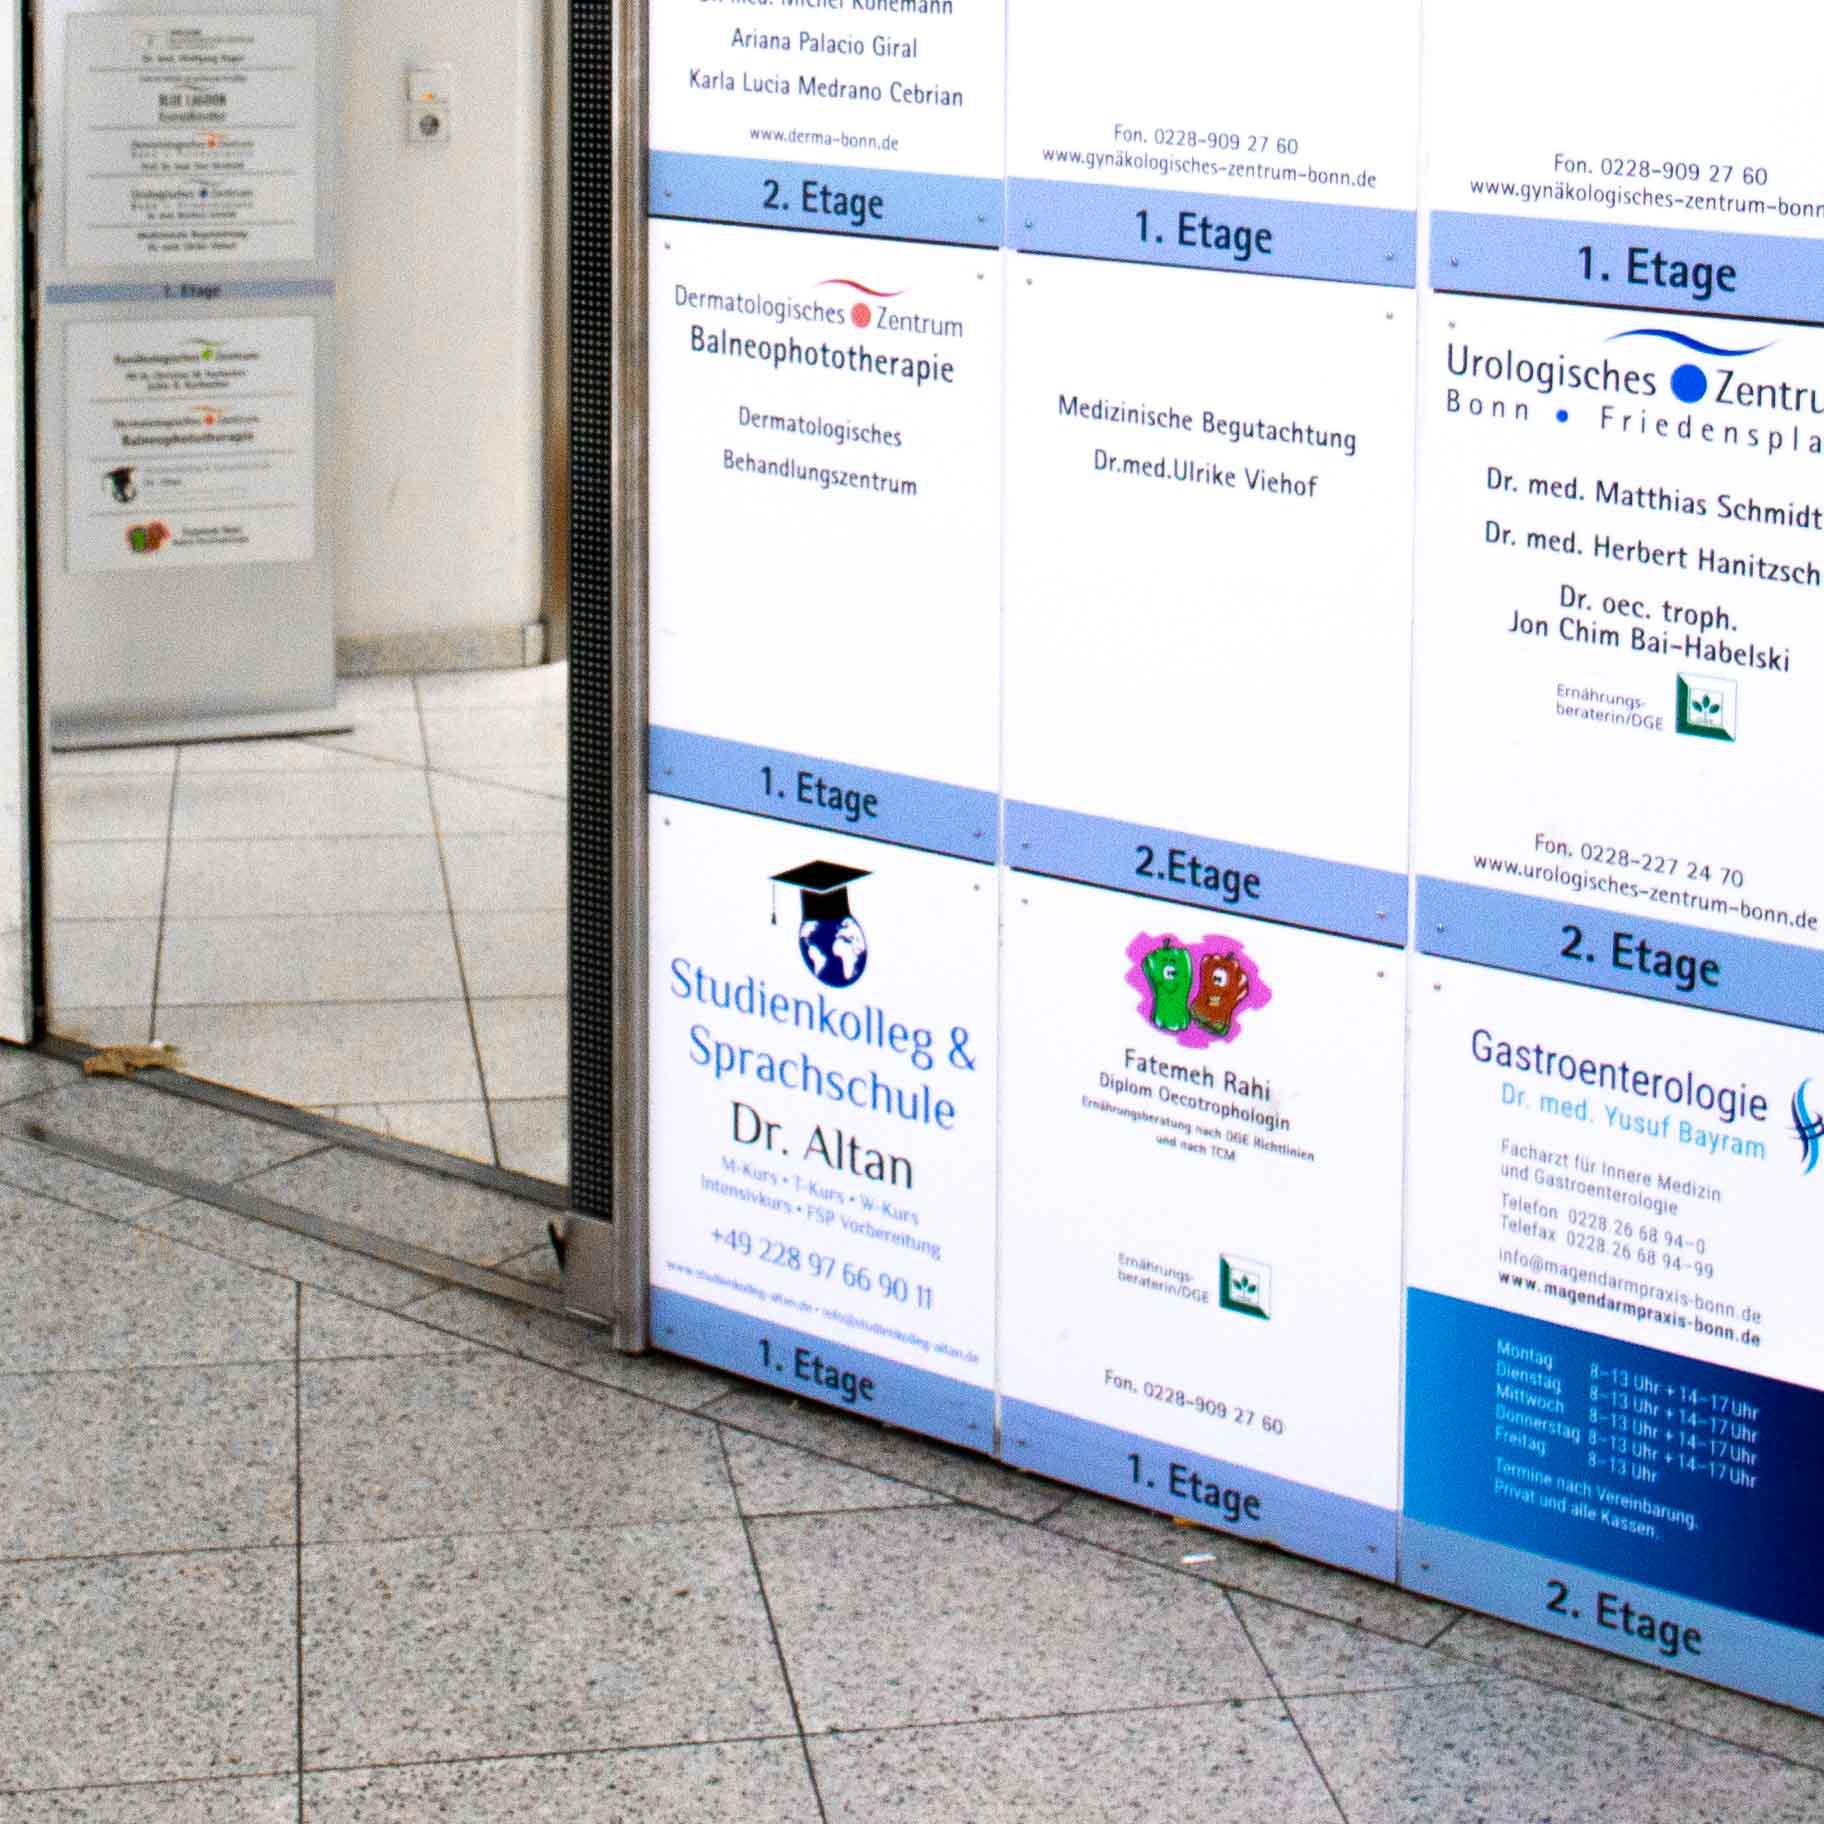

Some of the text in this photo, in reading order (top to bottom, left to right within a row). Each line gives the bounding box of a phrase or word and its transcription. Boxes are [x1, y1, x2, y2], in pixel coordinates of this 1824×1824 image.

[750, 129, 899, 151] www.derma-bonn.de
[763, 179, 884, 227] 2. Etage
[1136, 210, 1272, 263] 1. Etage
[1578, 246, 1737, 301] 1. Etage
[675, 283, 963, 338] Dermatologisches Zentrum
[691, 324, 954, 384] Balneophototherapie
[1448, 343, 1657, 397] Urologisches
[739, 405, 902, 448] Dermatologisches
[1058, 394, 1357, 457] Medizinische Begutachtung
[1446, 388, 1528, 421] Bonn
[723, 448, 918, 496] Behandlungszentrum
[1094, 448, 1318, 497] Dr.med.Ulrike Viehof
[761, 765, 879, 821] 1. Etage
[1135, 845, 1261, 903] 2.Etage
[1561, 925, 1721, 991] 2. Etage
[671, 958, 975, 1071] Studienkolleg &
[690, 1025, 956, 1128] Sprachschule
[1099, 1071, 1290, 1132] Diplom Oecotrophologin
[1124, 1047, 1271, 1103] Fatemeh Rahi
[1471, 1028, 1769, 1125] Gastroenterologie
[732, 1101, 912, 1190] Dr. Altan
[1502, 1082, 1766, 1160] Dr. med. Yusuf Bayram
[759, 1338, 875, 1403] 1. Etage
[1127, 1453, 1261, 1522] 1. Etage
[1545, 1581, 1702, 1656] 2. Etage
